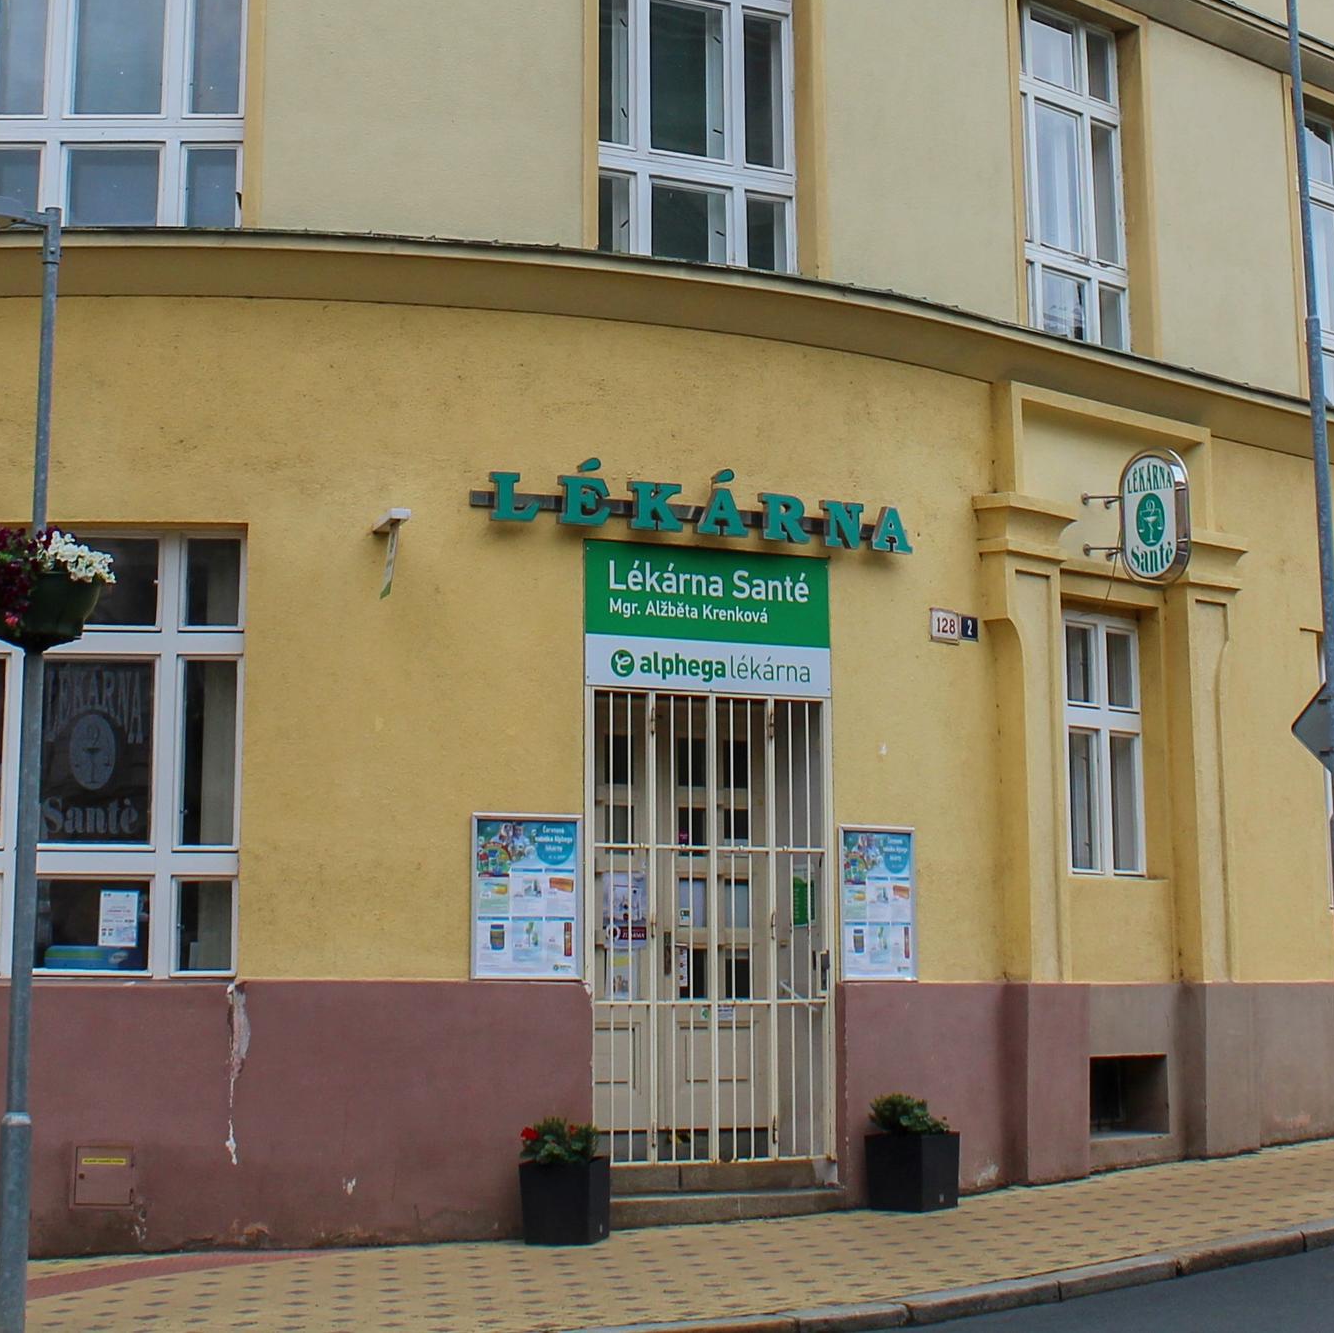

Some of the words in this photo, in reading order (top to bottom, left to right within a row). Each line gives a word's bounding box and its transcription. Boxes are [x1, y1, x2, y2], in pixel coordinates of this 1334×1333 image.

[1127, 462, 1172, 494] LÉKÁRNA
[488, 457, 913, 555] LÉKÁRNA
[608, 559, 724, 598] Lékárna
[732, 569, 810, 603] Santé
[609, 597, 641, 619] Mgr.
[645, 599, 698, 620] Alžběta
[703, 604, 768, 624] Krenková
[937, 617, 956, 635] 128
[967, 619, 973, 636] 2
[639, 651, 727, 683] alphega
[730, 655, 811, 683] lékárna
